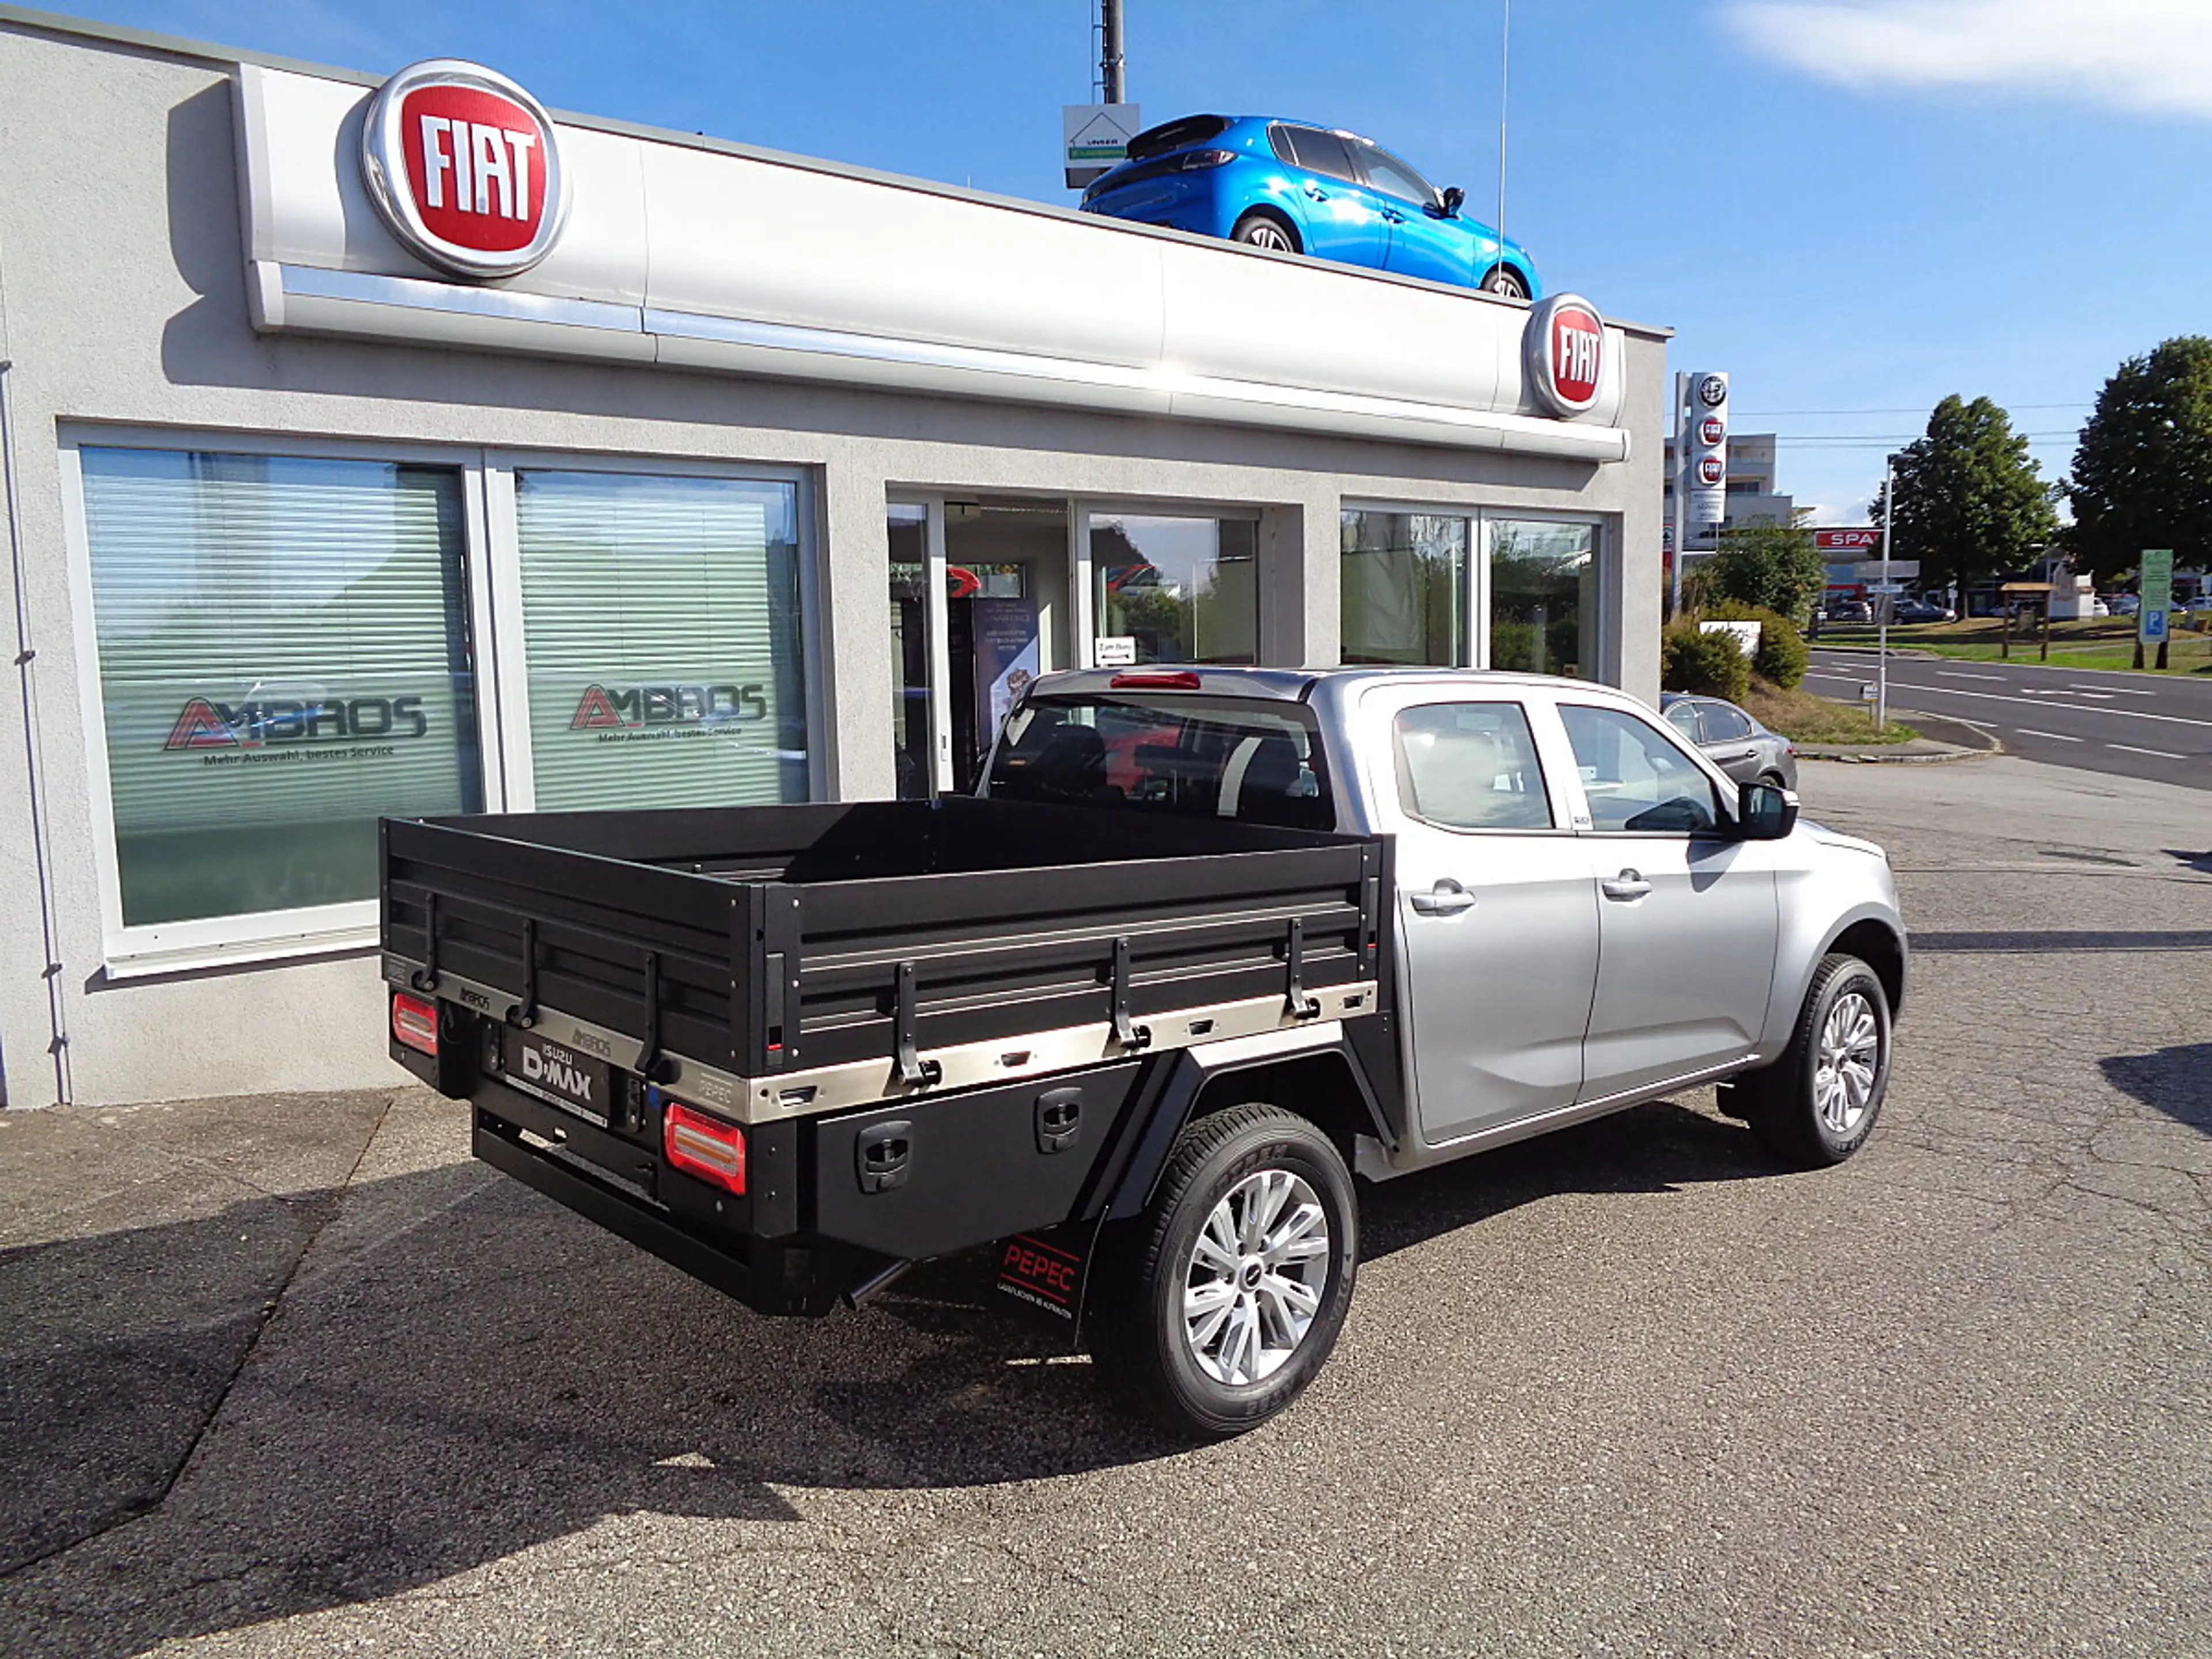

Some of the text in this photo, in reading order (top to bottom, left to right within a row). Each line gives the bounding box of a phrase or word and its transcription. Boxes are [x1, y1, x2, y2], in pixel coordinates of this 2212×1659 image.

[420, 115, 535, 221] FIAT
[1559, 325, 1600, 384] FIAT
[1831, 533, 1879, 545] SPA
[164, 696, 427, 751] AMBROS
[570, 683, 767, 730] AMBROS
[204, 745, 395, 766] Mehr Auswahl, bestes Service
[543, 1043, 573, 1066] ISUZU
[1004, 1244, 1075, 1291] PEPEC
